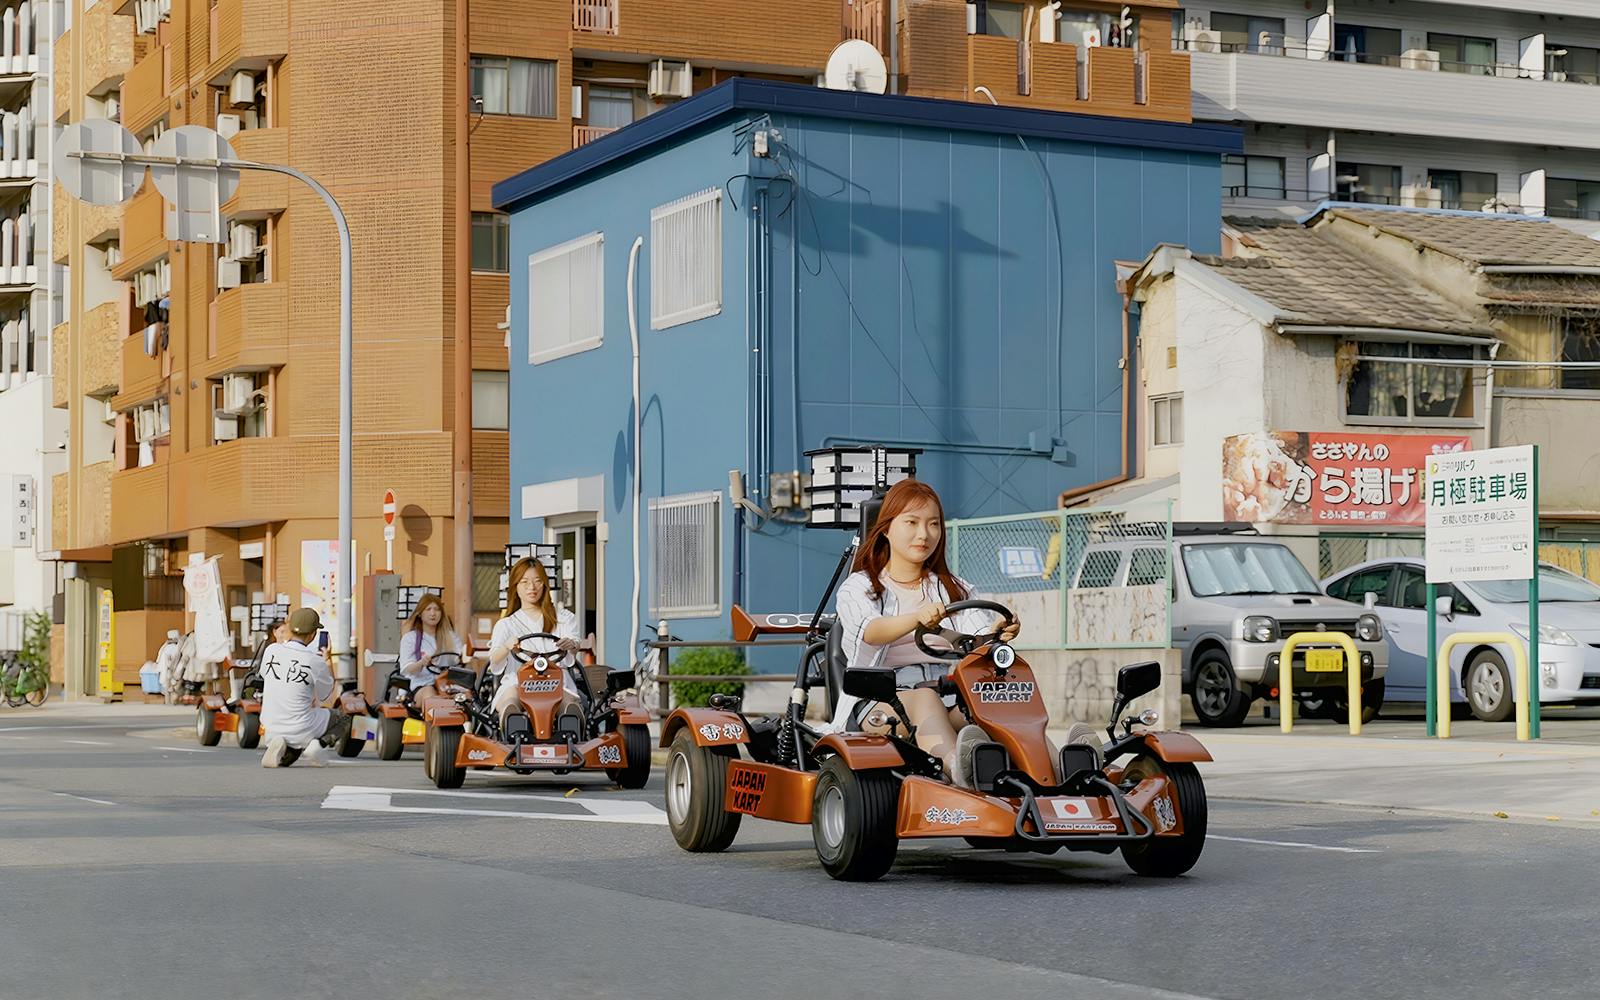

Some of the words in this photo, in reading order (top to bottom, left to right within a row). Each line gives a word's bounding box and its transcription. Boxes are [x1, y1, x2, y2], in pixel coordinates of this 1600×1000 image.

[1312, 441, 1390, 462] ささやんの
[1284, 465, 1417, 506] から揚げ
[1431, 472, 1528, 506] 月極駐車場
[265, 654, 312, 686] 大阪
[971, 682, 1034, 693] JAPAN
[981, 692, 1033, 703] KART
[731, 768, 767, 793] JAPAN
[732, 790, 761, 813] KART
